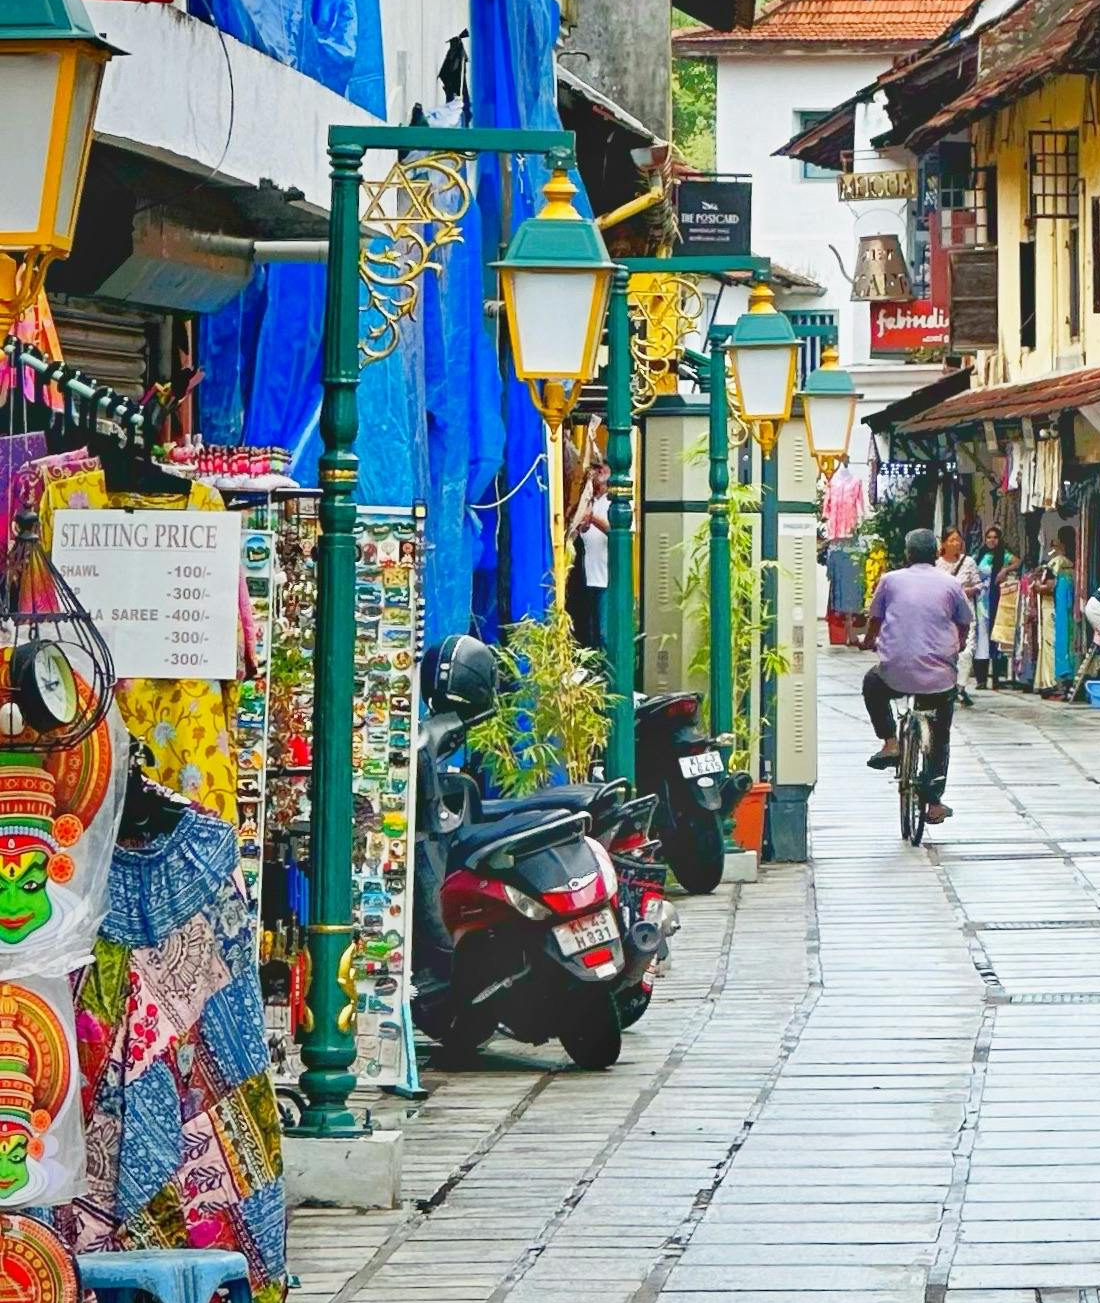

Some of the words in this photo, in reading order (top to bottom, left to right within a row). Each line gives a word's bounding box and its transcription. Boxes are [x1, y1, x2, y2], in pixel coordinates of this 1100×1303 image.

[876, 307, 950, 338] fabindi
[61, 523, 149, 548] STARTING
[155, 524, 218, 549] PRICE
[60, 565, 99, 577] SHAWL
[167, 566, 212, 578] -100/-
[166, 587, 211, 600] -300/-
[111, 608, 159, 621] SAREE
[165, 609, 210, 621] -400/-
[164, 631, 209, 644] -300/-
[163, 652, 209, 666] -300/-
